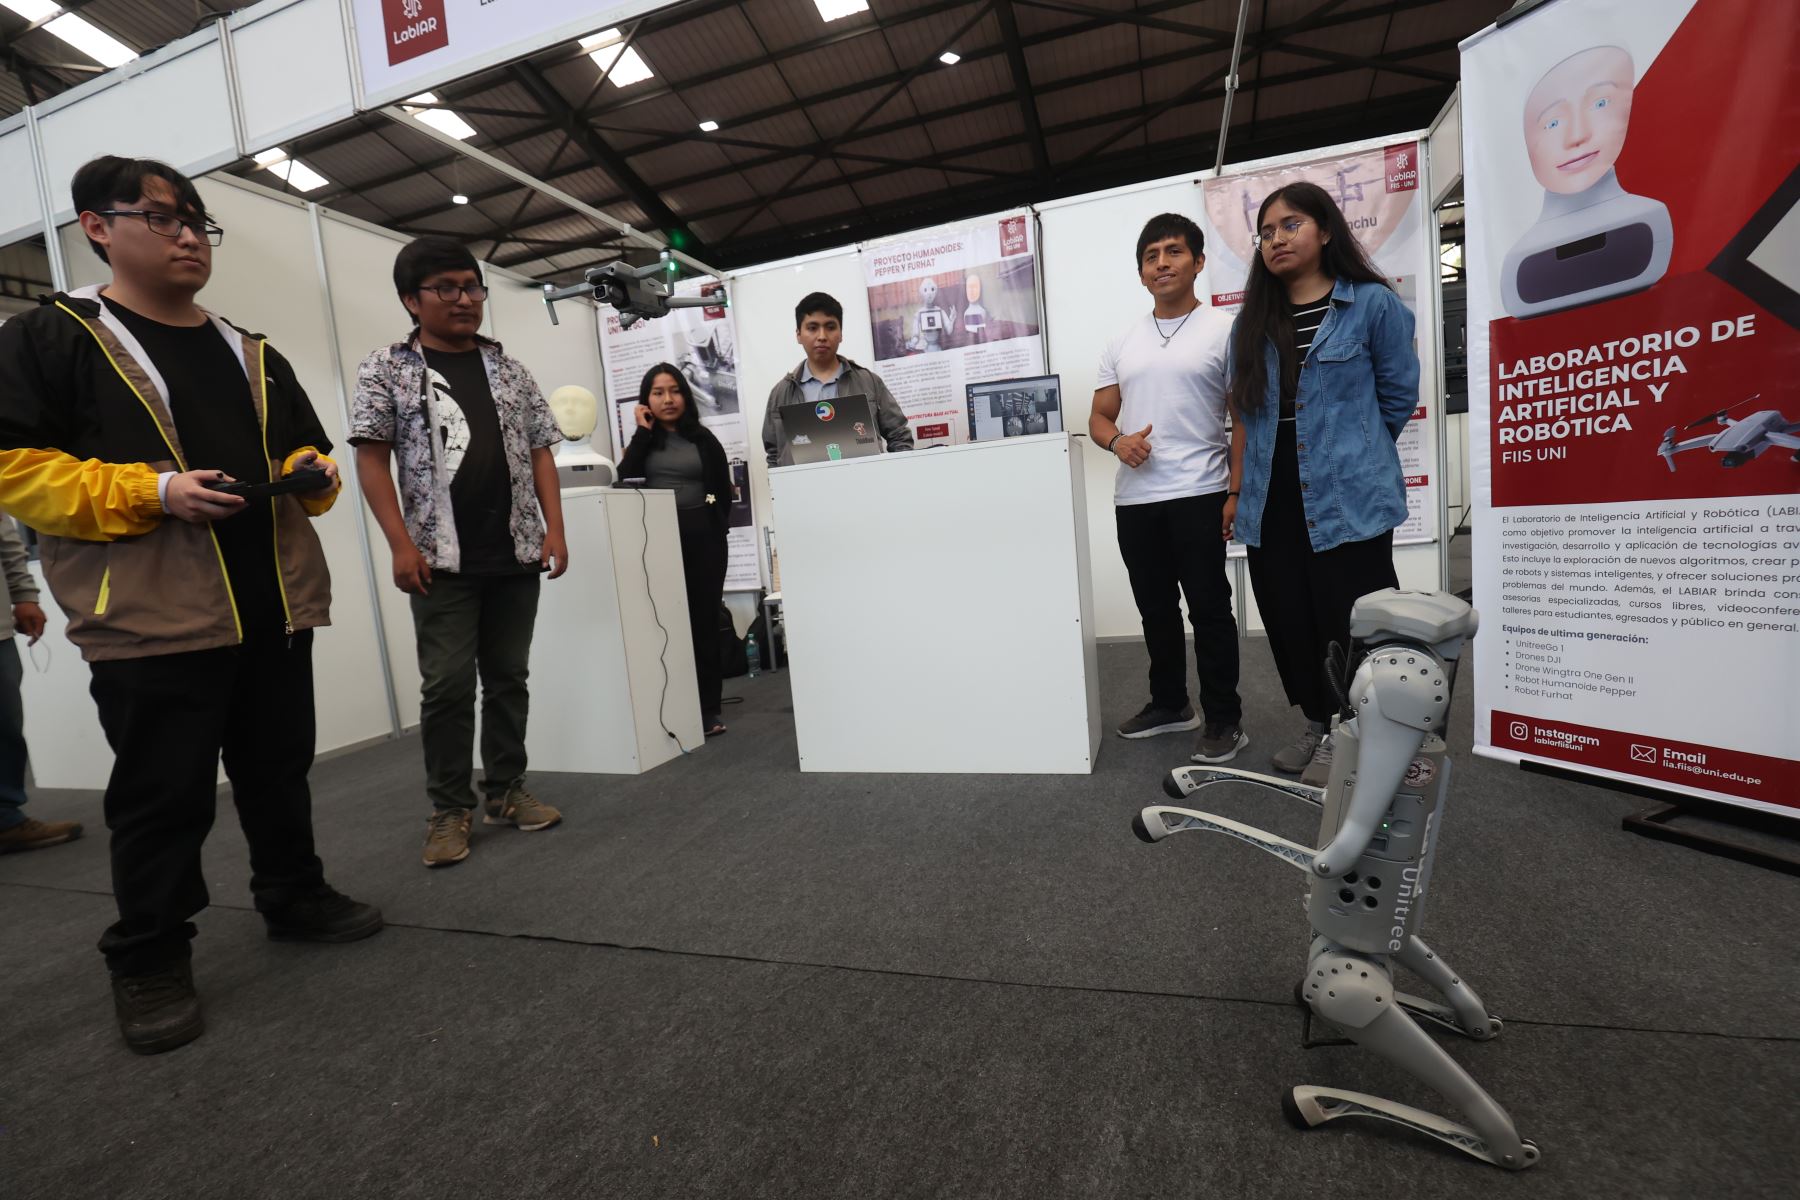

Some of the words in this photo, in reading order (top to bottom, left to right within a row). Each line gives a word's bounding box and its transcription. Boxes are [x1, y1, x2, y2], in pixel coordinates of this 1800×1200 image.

[393, 17, 437, 45] LabIAR
[1390, 170, 1416, 182] LabIAR
[874, 253, 912, 266] PROYECTO
[874, 265, 900, 277] PEPPER
[901, 264, 906, 272] Y
[908, 258, 935, 272] FURHAT
[1498, 326, 1700, 380] LABORATORIO
[1711, 314, 1756, 342] DE
[1498, 355, 1688, 401] INTELIGENCIA
[1498, 387, 1639, 423] ARTIFICIAL
[1647, 382, 1670, 403] Y
[1500, 413, 1632, 444] ROBÓTICA
[1502, 449, 1532, 464] FIIS
[1536, 446, 1566, 460] UNI
[1513, 515, 1561, 523] Laboratorio
[1580, 512, 1640, 523] Inteligencia
[1646, 510, 1686, 519] Artificial
[1691, 511, 1698, 520] y
[1704, 507, 1759, 518] Robótica
[1531, 529, 1564, 538] objetivo
[1568, 528, 1616, 537] promover
[1622, 527, 1632, 535] la
[1637, 526, 1696, 536] inteligencia
[1703, 524, 1753, 534] artificial
[1776, 524, 1800, 533] trav
[1503, 542, 1559, 551] investigación,
[1563, 542, 1610, 550] desarrollo
[1626, 541, 1678, 552] aplicación
[1683, 541, 1698, 549] de
[1703, 541, 1777, 551] tecnologías
[1503, 555, 1520, 563] Esto
[1522, 555, 1551, 564] incluye
[1564, 556, 1621, 565] exploración
[1624, 556, 1637, 564] de
[1680, 557, 1748, 567] algoritmos,
[1752, 558, 1786, 566] crear
[1544, 570, 1548, 578] y
[1551, 570, 1591, 578] sistemas
[1594, 570, 1654, 580] inteligentes,
[1657, 573, 1663, 581] y
[1666, 571, 1707, 580] ofrecer
[1711, 572, 1778, 582] soluciones
[1503, 582, 1546, 590] problemas
[1569, 584, 1608, 592] mundo.
[1614, 584, 1656, 594] Además,
[1679, 588, 1716, 596] LABIAR
[1725, 588, 1766, 597] brinda
[1548, 597, 1621, 607] especializadas,
[1629, 601, 1662, 609] cursos
[1672, 602, 1706, 612] libres,
[1717, 604, 1800, 616] videoconfere
[1503, 607, 1532, 615] talleres
[1534, 609, 1552, 618] para
[1555, 610, 1613, 620] estudiantes,
[1616, 614, 1668, 624] egresados
[1672, 618, 1678, 626] y
[1681, 618, 1725, 628] público
[1728, 620, 1743, 628] en
[1747, 622, 1799, 632] general.
[1502, 625, 1536, 635] Equipos
[1538, 628, 1549, 636] de
[1551, 629, 1584, 638] ultima
[1587, 631, 1648, 644] generación:
[1515, 651, 1545, 662] Drones
[1547, 655, 1561, 664] DJI
[1515, 663, 1540, 673] Drone
[1543, 667, 1581, 678] Wingtra
[1584, 671, 1602, 680] One
[1605, 673, 1625, 683] Gen
[1515, 674, 1540, 685] Robot
[1541, 676, 1597, 692] Humanoide
[1600, 685, 1636, 698] Pepper
[1515, 686, 1540, 696] Robot
[1541, 690, 1573, 700] Furhat
[1534, 726, 1600, 746] Instagram
[1663, 748, 1706, 765] Email
[1663, 760, 1762, 785] lia.fiis@uni.edu.pe
[1389, 867, 1418, 951] Unitree
